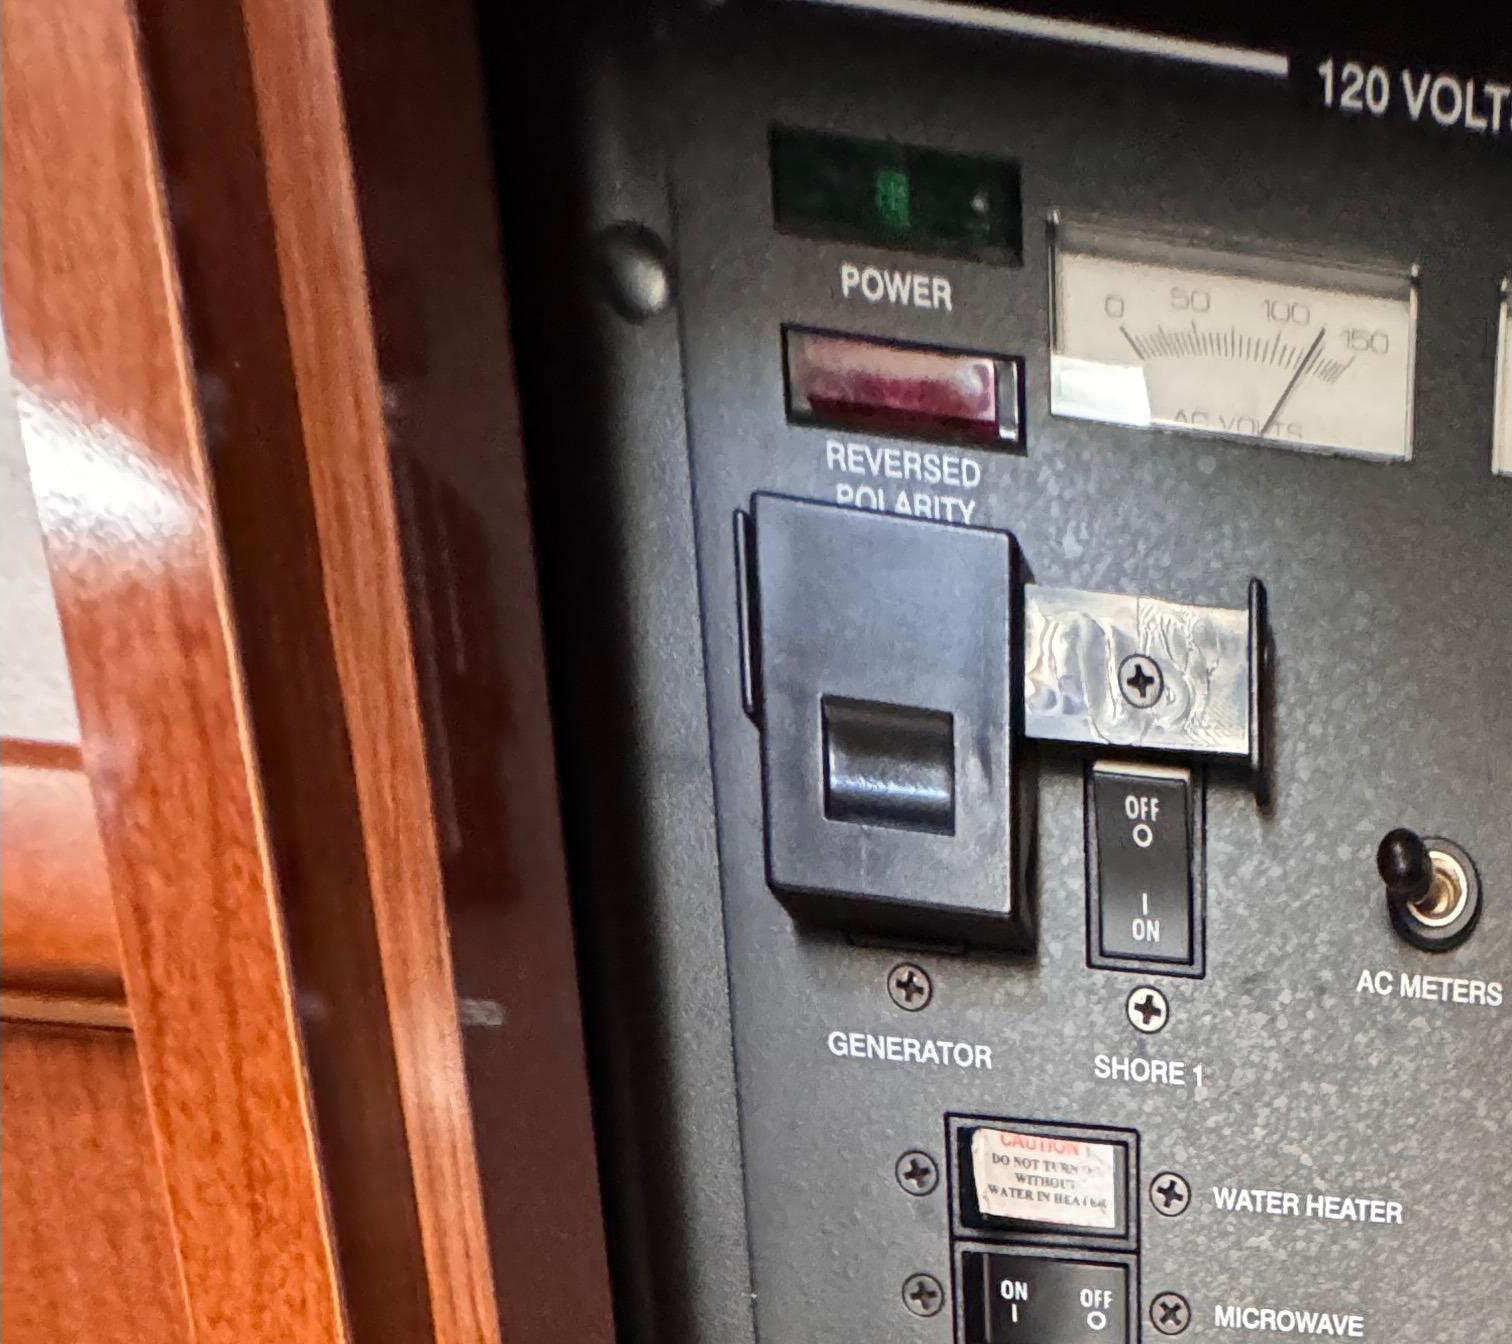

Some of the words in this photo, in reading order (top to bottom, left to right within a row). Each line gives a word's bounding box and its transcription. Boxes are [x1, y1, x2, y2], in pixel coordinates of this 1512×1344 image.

[1317, 59, 1388, 114] 120
[840, 264, 953, 311] POWER
[1105, 295, 1125, 318] 0
[1170, 286, 1211, 314] 50
[1265, 300, 1310, 325] 100
[1342, 327, 1389, 354] 150
[826, 440, 981, 488] REVERSED
[836, 482, 976, 525] POLARITY
[1124, 795, 1160, 822] OFF
[1131, 918, 1161, 943] ON
[1357, 970, 1394, 996] AC
[1400, 974, 1503, 1006] METERS
[828, 1031, 992, 1069] GENERATOR
[1094, 1055, 1186, 1086] SHORE
[1193, 1063, 1205, 1086] 1
[992, 1153, 1010, 1165] DO
[1014, 1156, 1040, 1170] NOT
[988, 1184, 1034, 1201] WATER
[1037, 1191, 1051, 1202] IN
[1213, 1186, 1300, 1217] WATER
[1306, 1194, 1403, 1225] HEATER
[1000, 1279, 1028, 1300] ON
[1080, 1288, 1113, 1309] OFF
[1214, 1305, 1365, 1338] MICROWAVE
